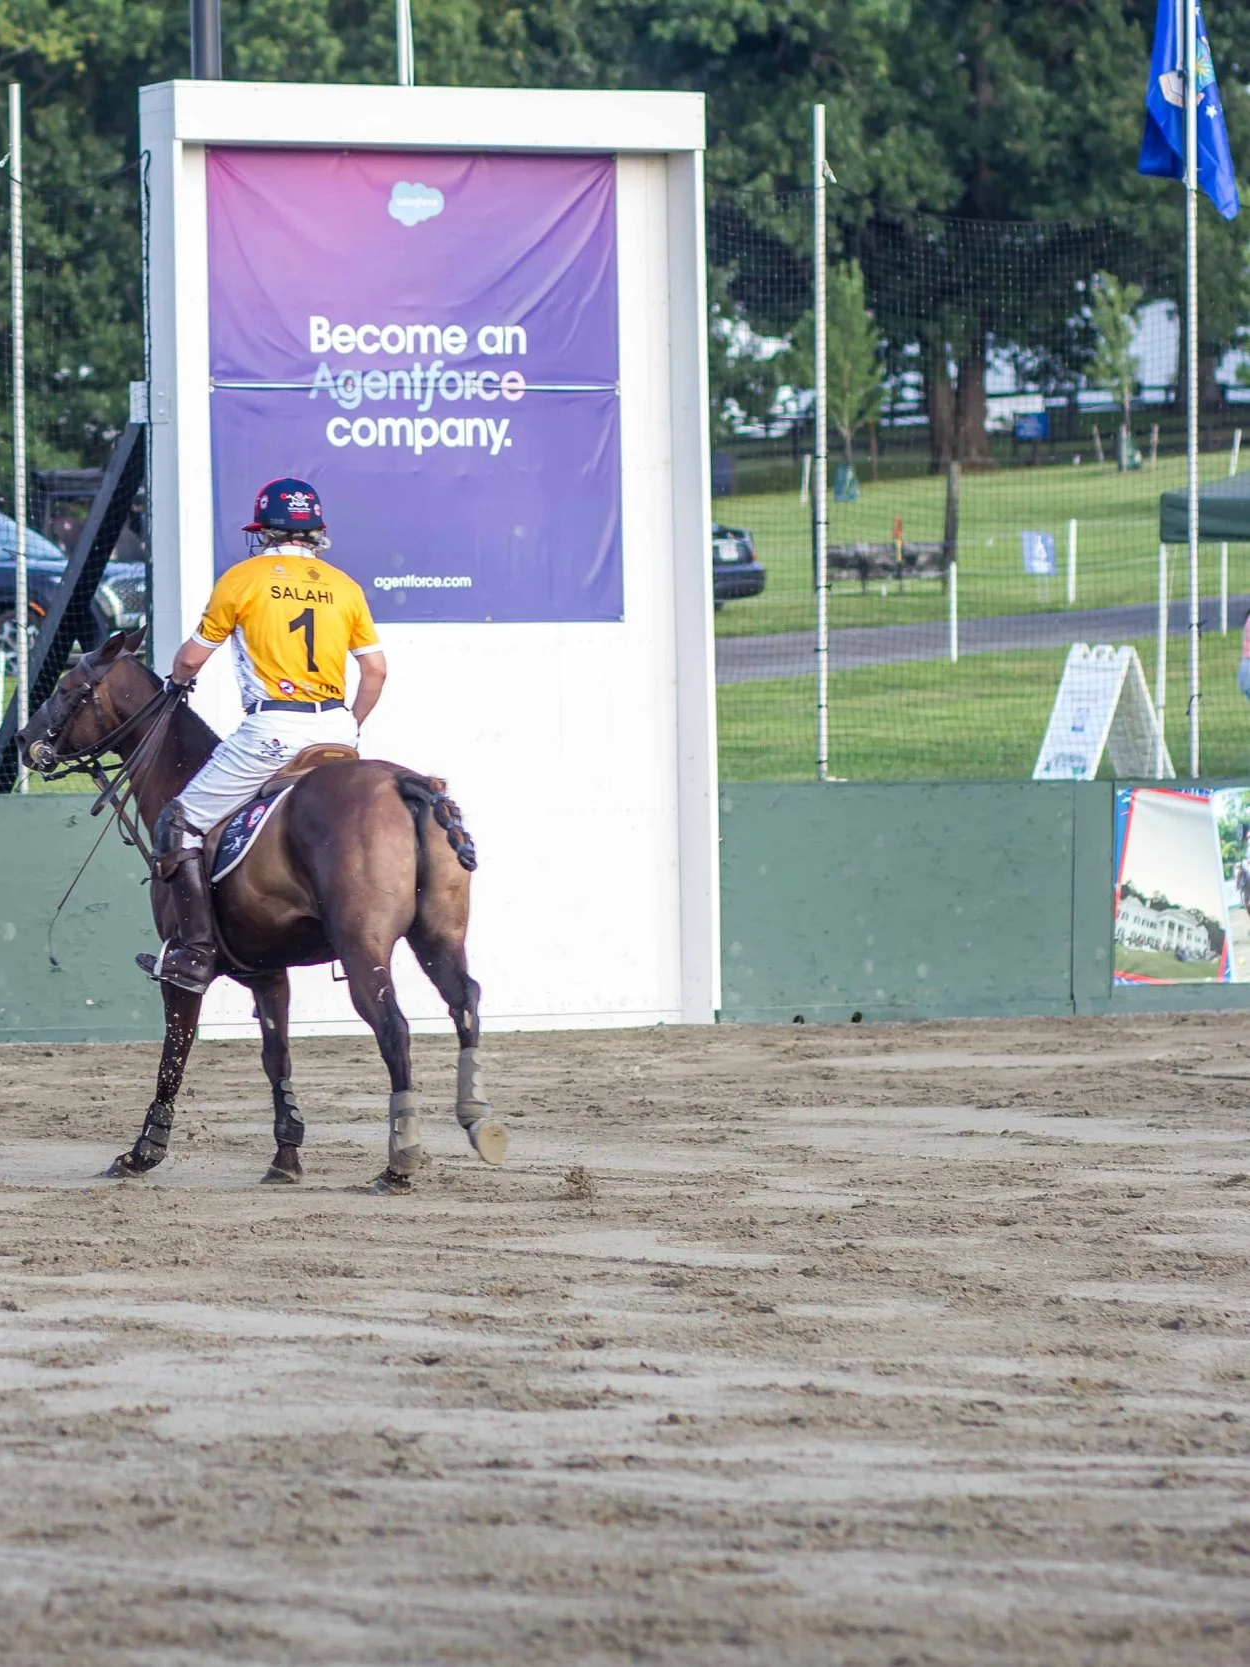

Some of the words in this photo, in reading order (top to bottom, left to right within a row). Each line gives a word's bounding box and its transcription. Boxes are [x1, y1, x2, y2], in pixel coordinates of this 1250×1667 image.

[309, 315, 468, 355] Become
[477, 324, 527, 355] an
[308, 360, 526, 412] Agentforce
[326, 416, 512, 455] company.
[270, 585, 334, 605] SALAHI
[374, 574, 472, 591] agentforce.com
[288, 608, 319, 672] 1
